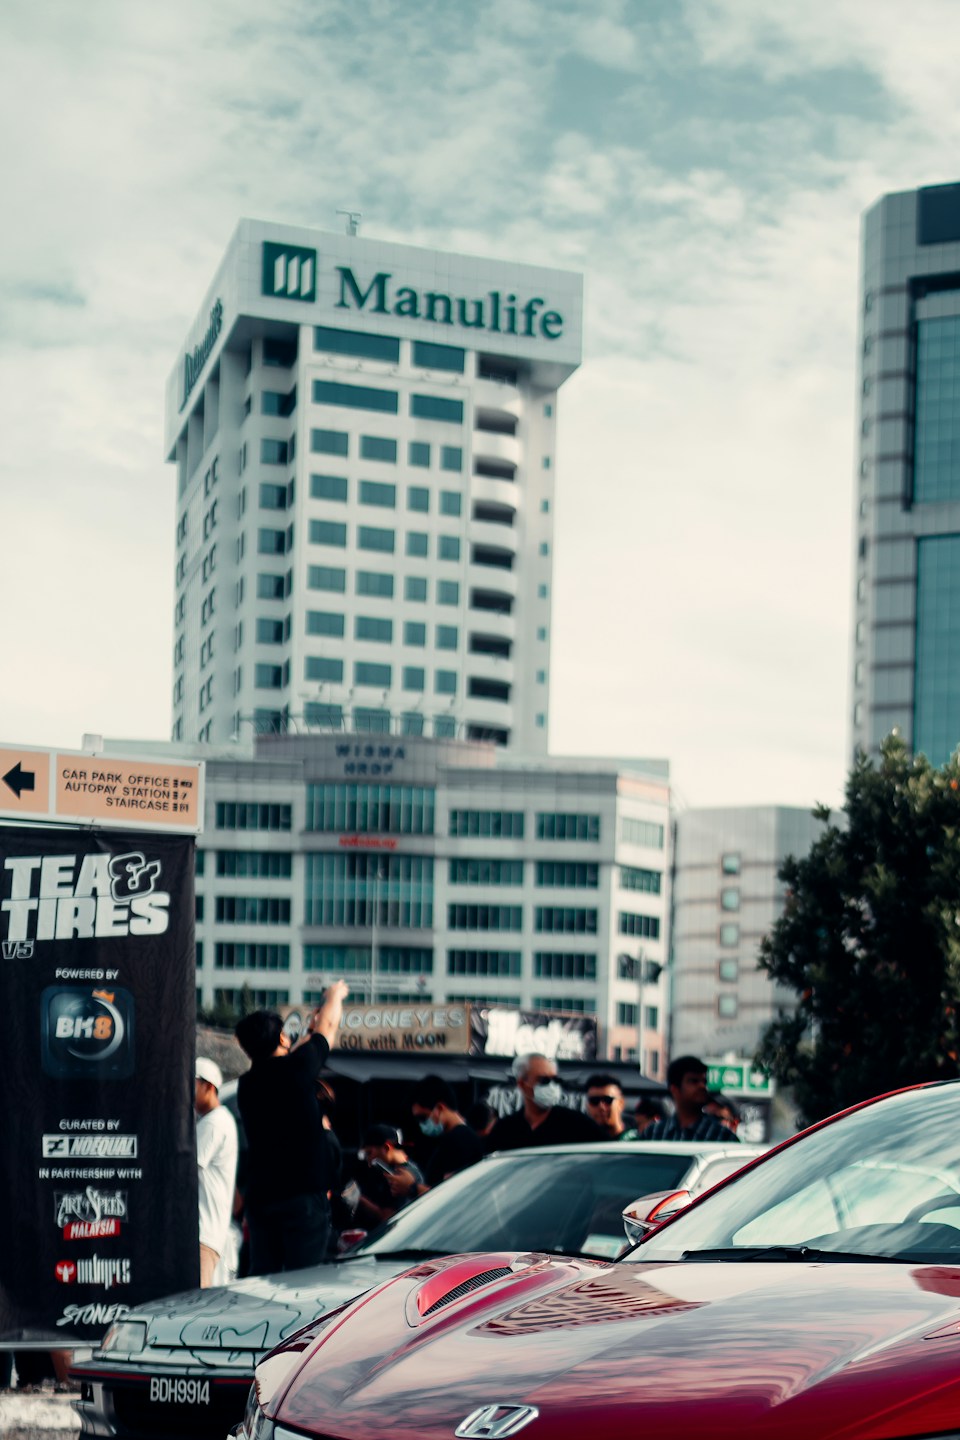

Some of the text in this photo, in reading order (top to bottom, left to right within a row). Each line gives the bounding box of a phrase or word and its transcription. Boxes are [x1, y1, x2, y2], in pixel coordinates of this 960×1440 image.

[335, 266, 563, 340] Manulife
[62, 769, 170, 788] CAR PARK OFFICE
[65, 782, 170, 799] AUTOPAY STATION
[106, 797, 169, 811] STAIRCASE
[4, 853, 113, 900] TEA
[1, 891, 170, 941] TIRES
[55, 967, 120, 980] POWERED BY
[367, 1033, 396, 1050] with
[402, 1033, 446, 1050] MOON
[59, 1118, 120, 1131] CURATED BY
[39, 1168, 142, 1179] IN PARTNERSHIP WITH
[70, 1218, 116, 1239] MALAYSIA
[149, 1377, 210, 1406] BDH9914
